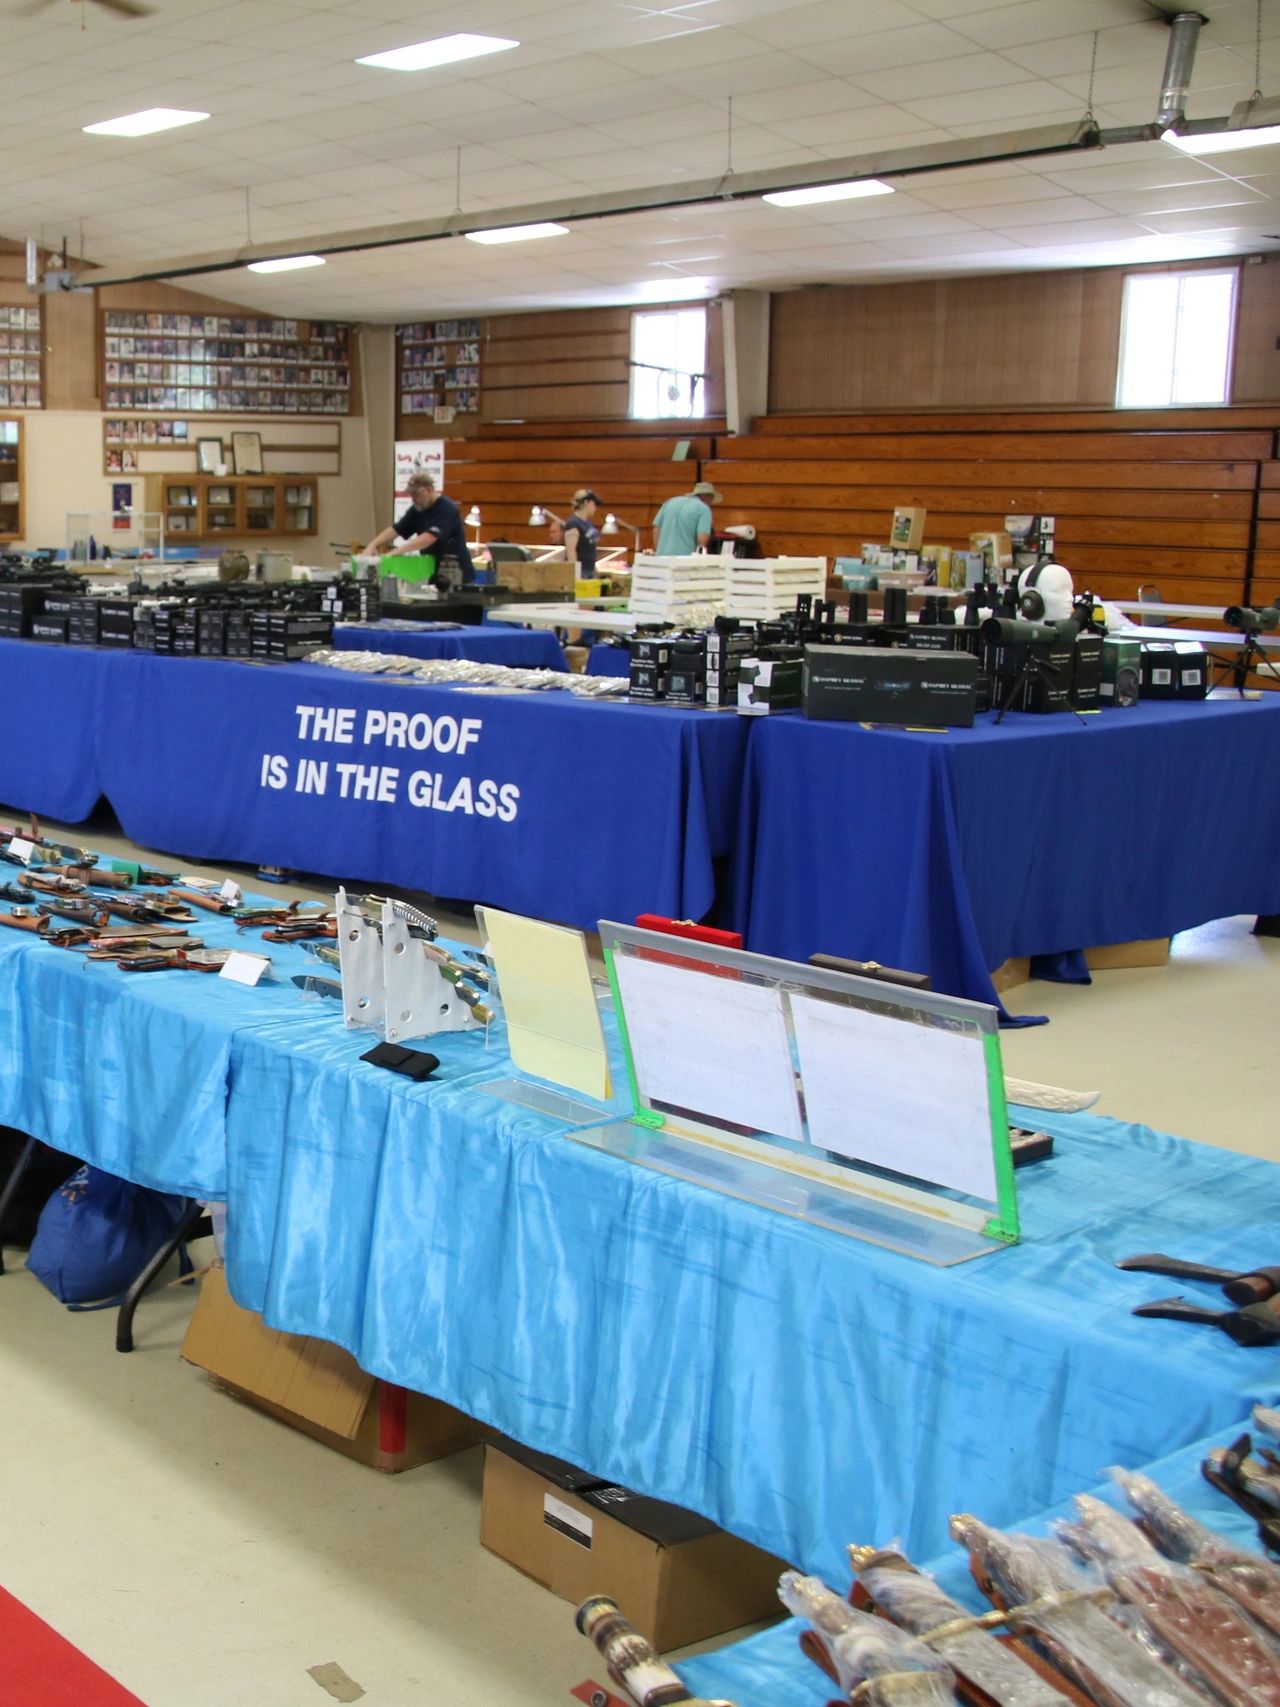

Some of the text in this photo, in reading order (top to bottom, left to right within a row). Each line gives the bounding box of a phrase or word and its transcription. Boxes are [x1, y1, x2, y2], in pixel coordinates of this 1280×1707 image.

[295, 704, 483, 755] THE PROOF
[260, 753, 521, 823] IS IN THE GLASS
